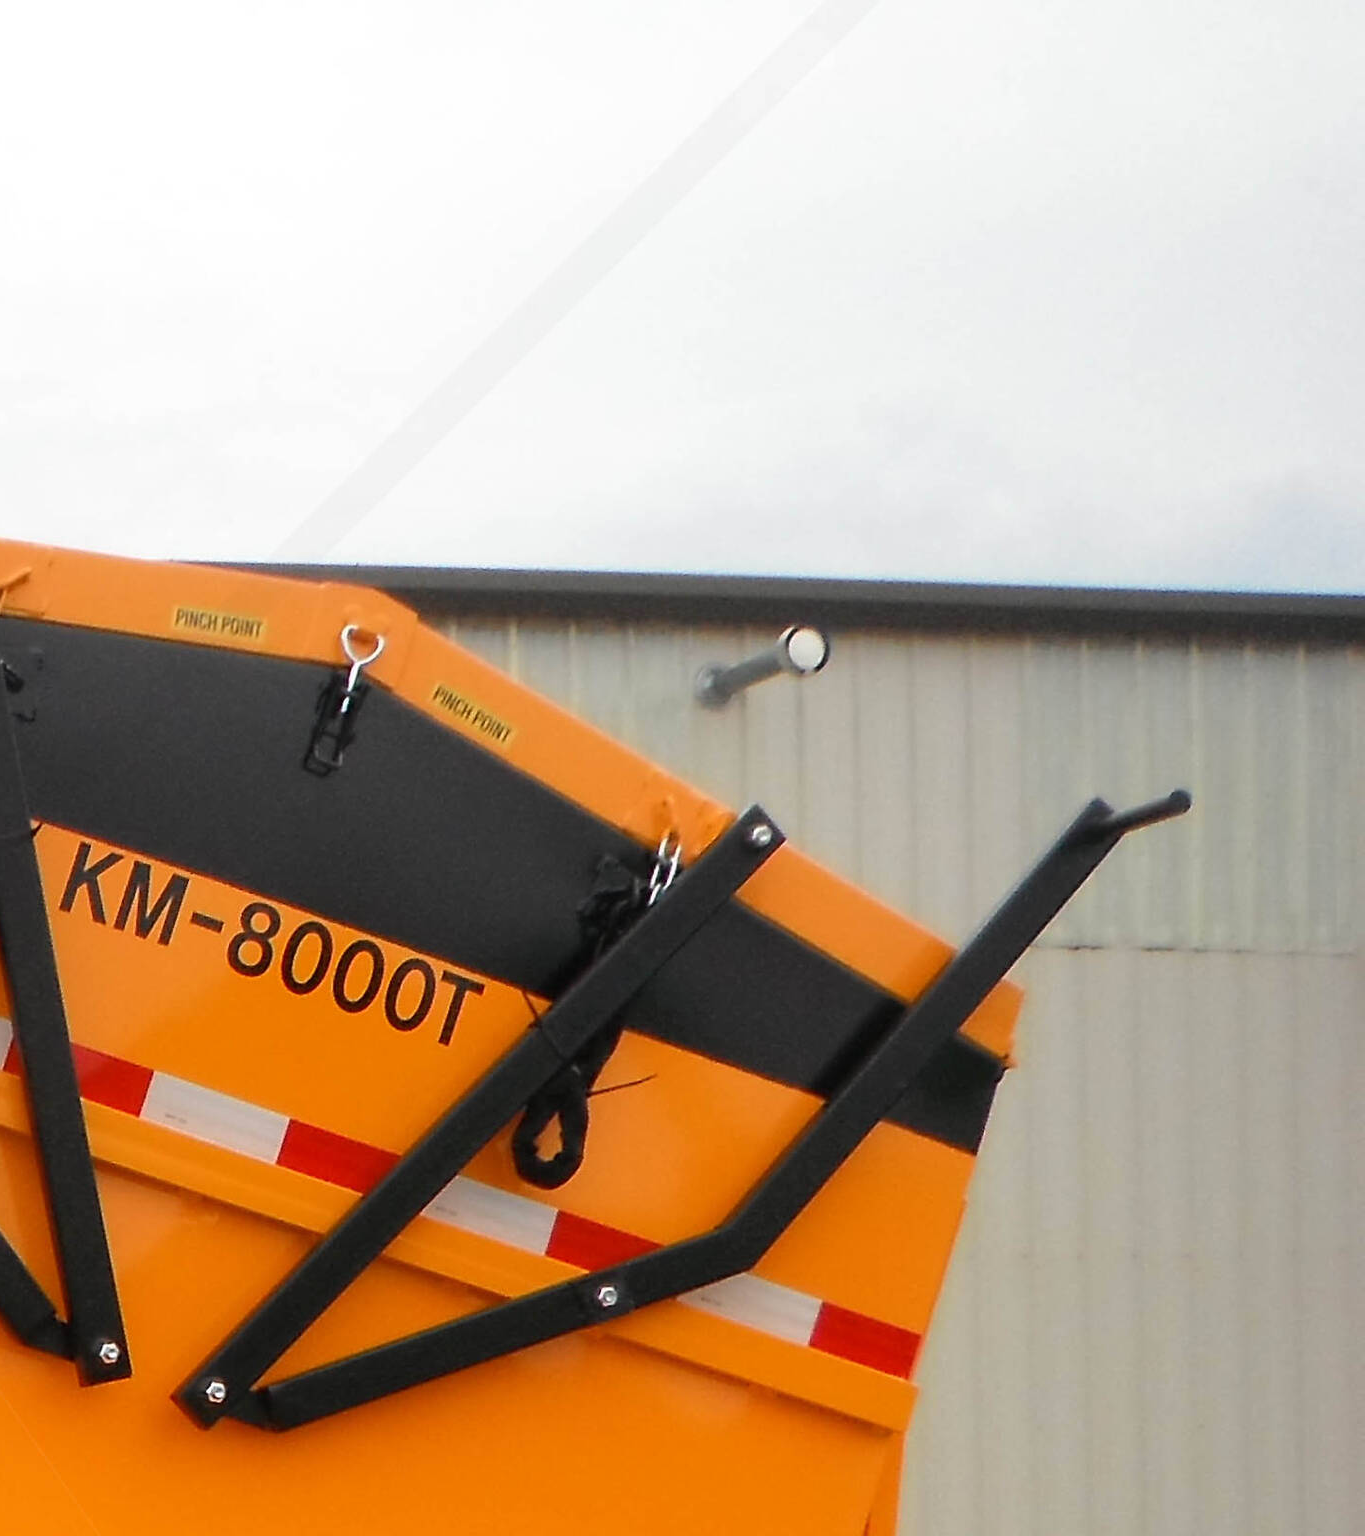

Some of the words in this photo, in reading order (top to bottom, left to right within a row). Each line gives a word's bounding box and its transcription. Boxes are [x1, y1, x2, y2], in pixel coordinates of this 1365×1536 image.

[174, 608, 218, 629] PINCH
[221, 616, 262, 638] POINT
[433, 685, 473, 719] PINCH
[470, 708, 511, 743] POINT
[59, 841, 485, 1047] KM-8000T
